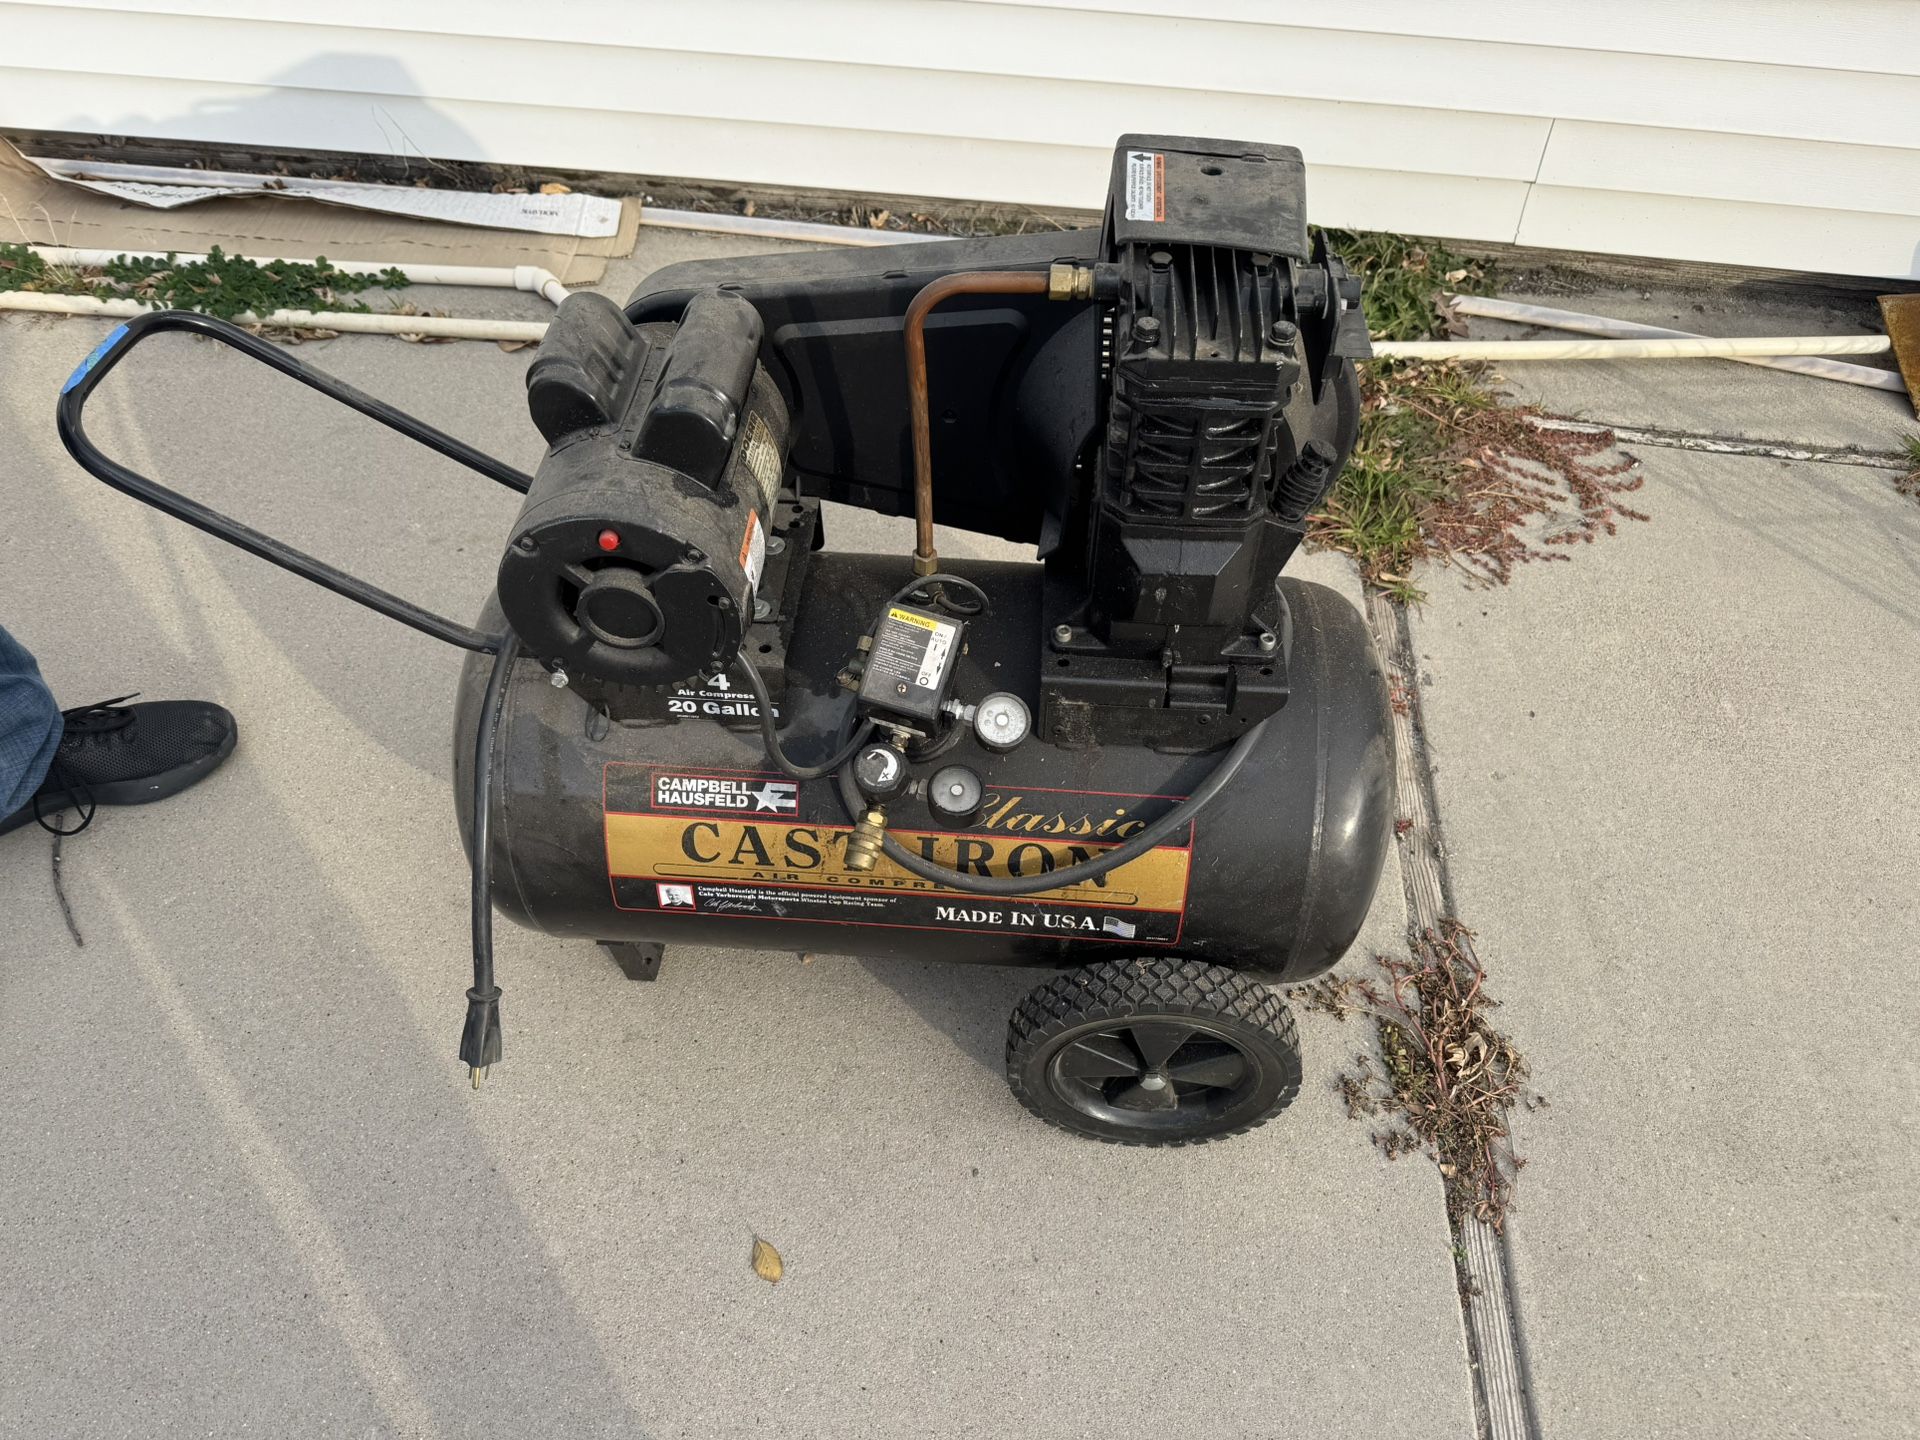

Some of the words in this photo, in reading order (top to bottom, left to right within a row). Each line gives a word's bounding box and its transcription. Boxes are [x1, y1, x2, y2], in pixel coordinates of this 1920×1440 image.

[740, 412, 759, 462] DOERR
[899, 614, 930, 627] WARNING
[931, 637, 947, 645] AUTO
[707, 673, 731, 691] 4
[699, 690, 755, 699] Compress
[668, 700, 697, 713] 20
[657, 777, 753, 795] CAMPBELL
[657, 790, 749, 808] HAUSFELD
[970, 794, 1146, 840] lassic
[681, 822, 863, 872] CAS
[752, 872, 799, 881] AIR
[935, 906, 1003, 925] MADE
[1010, 911, 1036, 926] IN
[1043, 914, 1100, 931] U.S.A.
